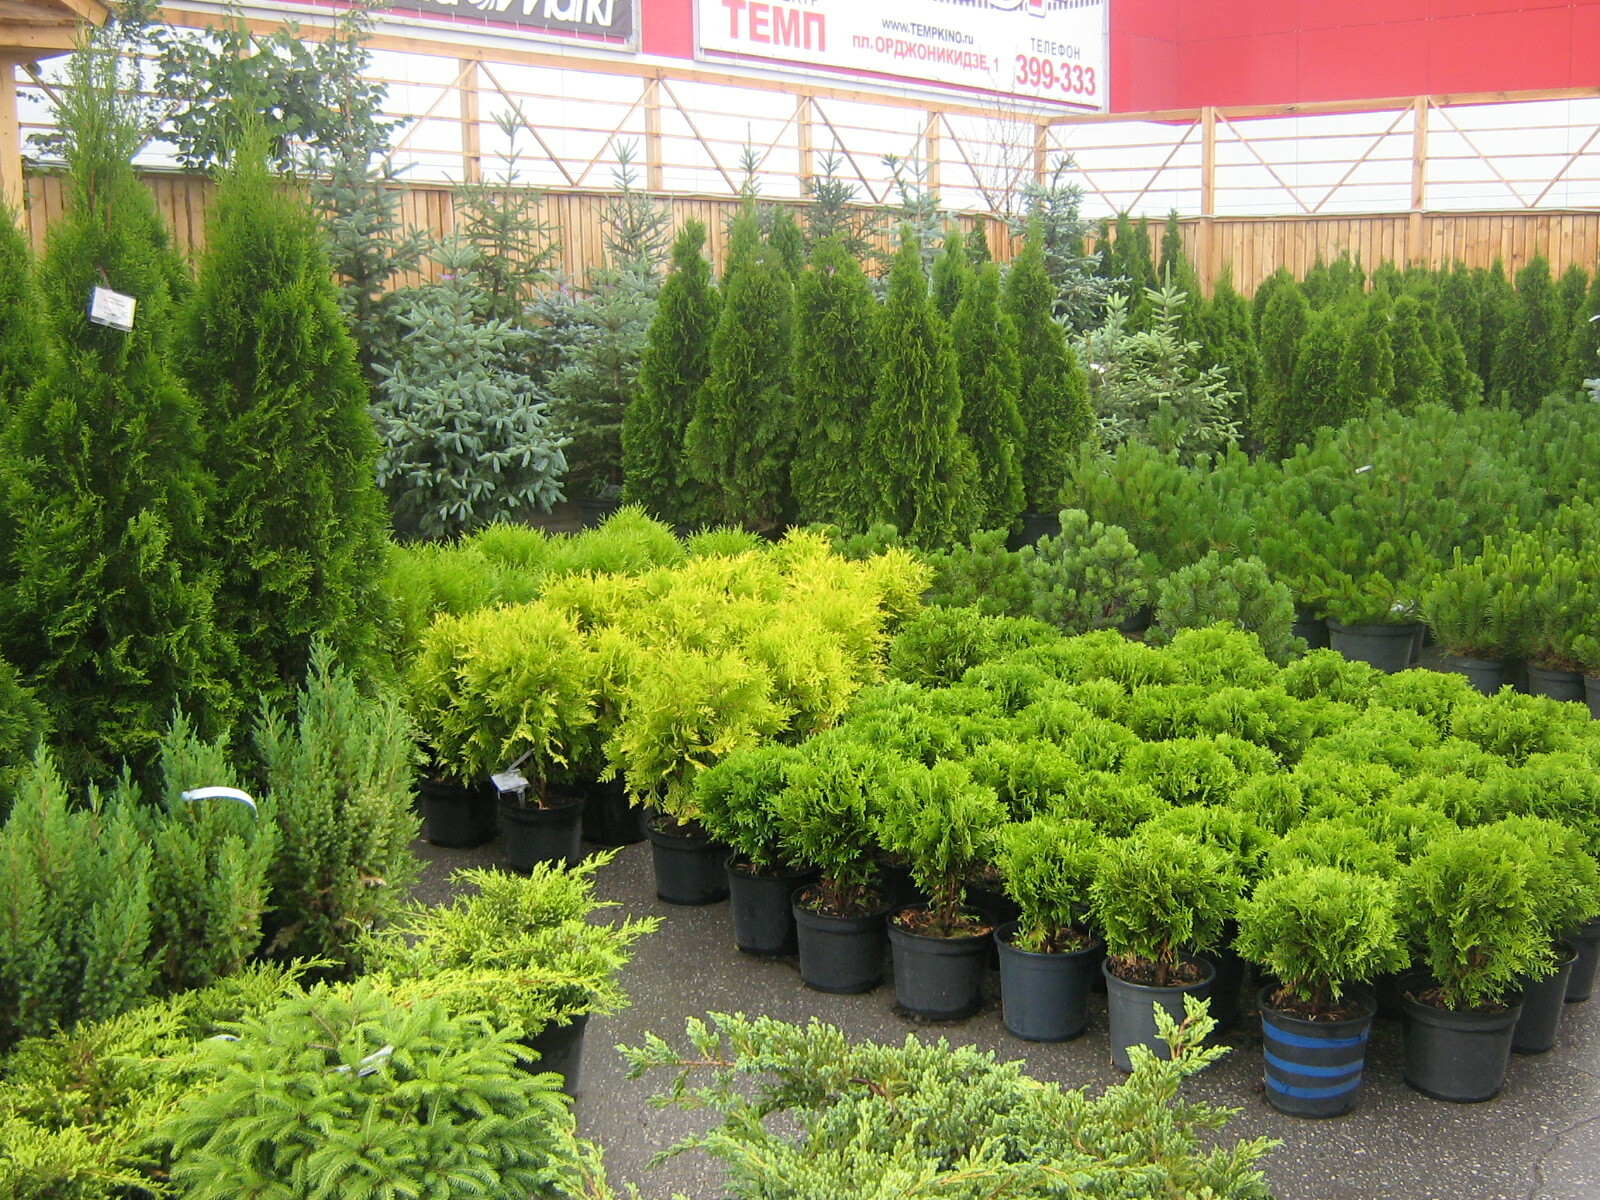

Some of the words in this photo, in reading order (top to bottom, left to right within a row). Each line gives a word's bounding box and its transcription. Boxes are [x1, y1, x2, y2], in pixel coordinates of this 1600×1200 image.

[722, 0, 826, 52] ТЕМП
[1030, 37, 1081, 60] ТЕЛЕФОН
[993, 57, 999, 73] 1
[1015, 54, 1096, 96] 399-333
